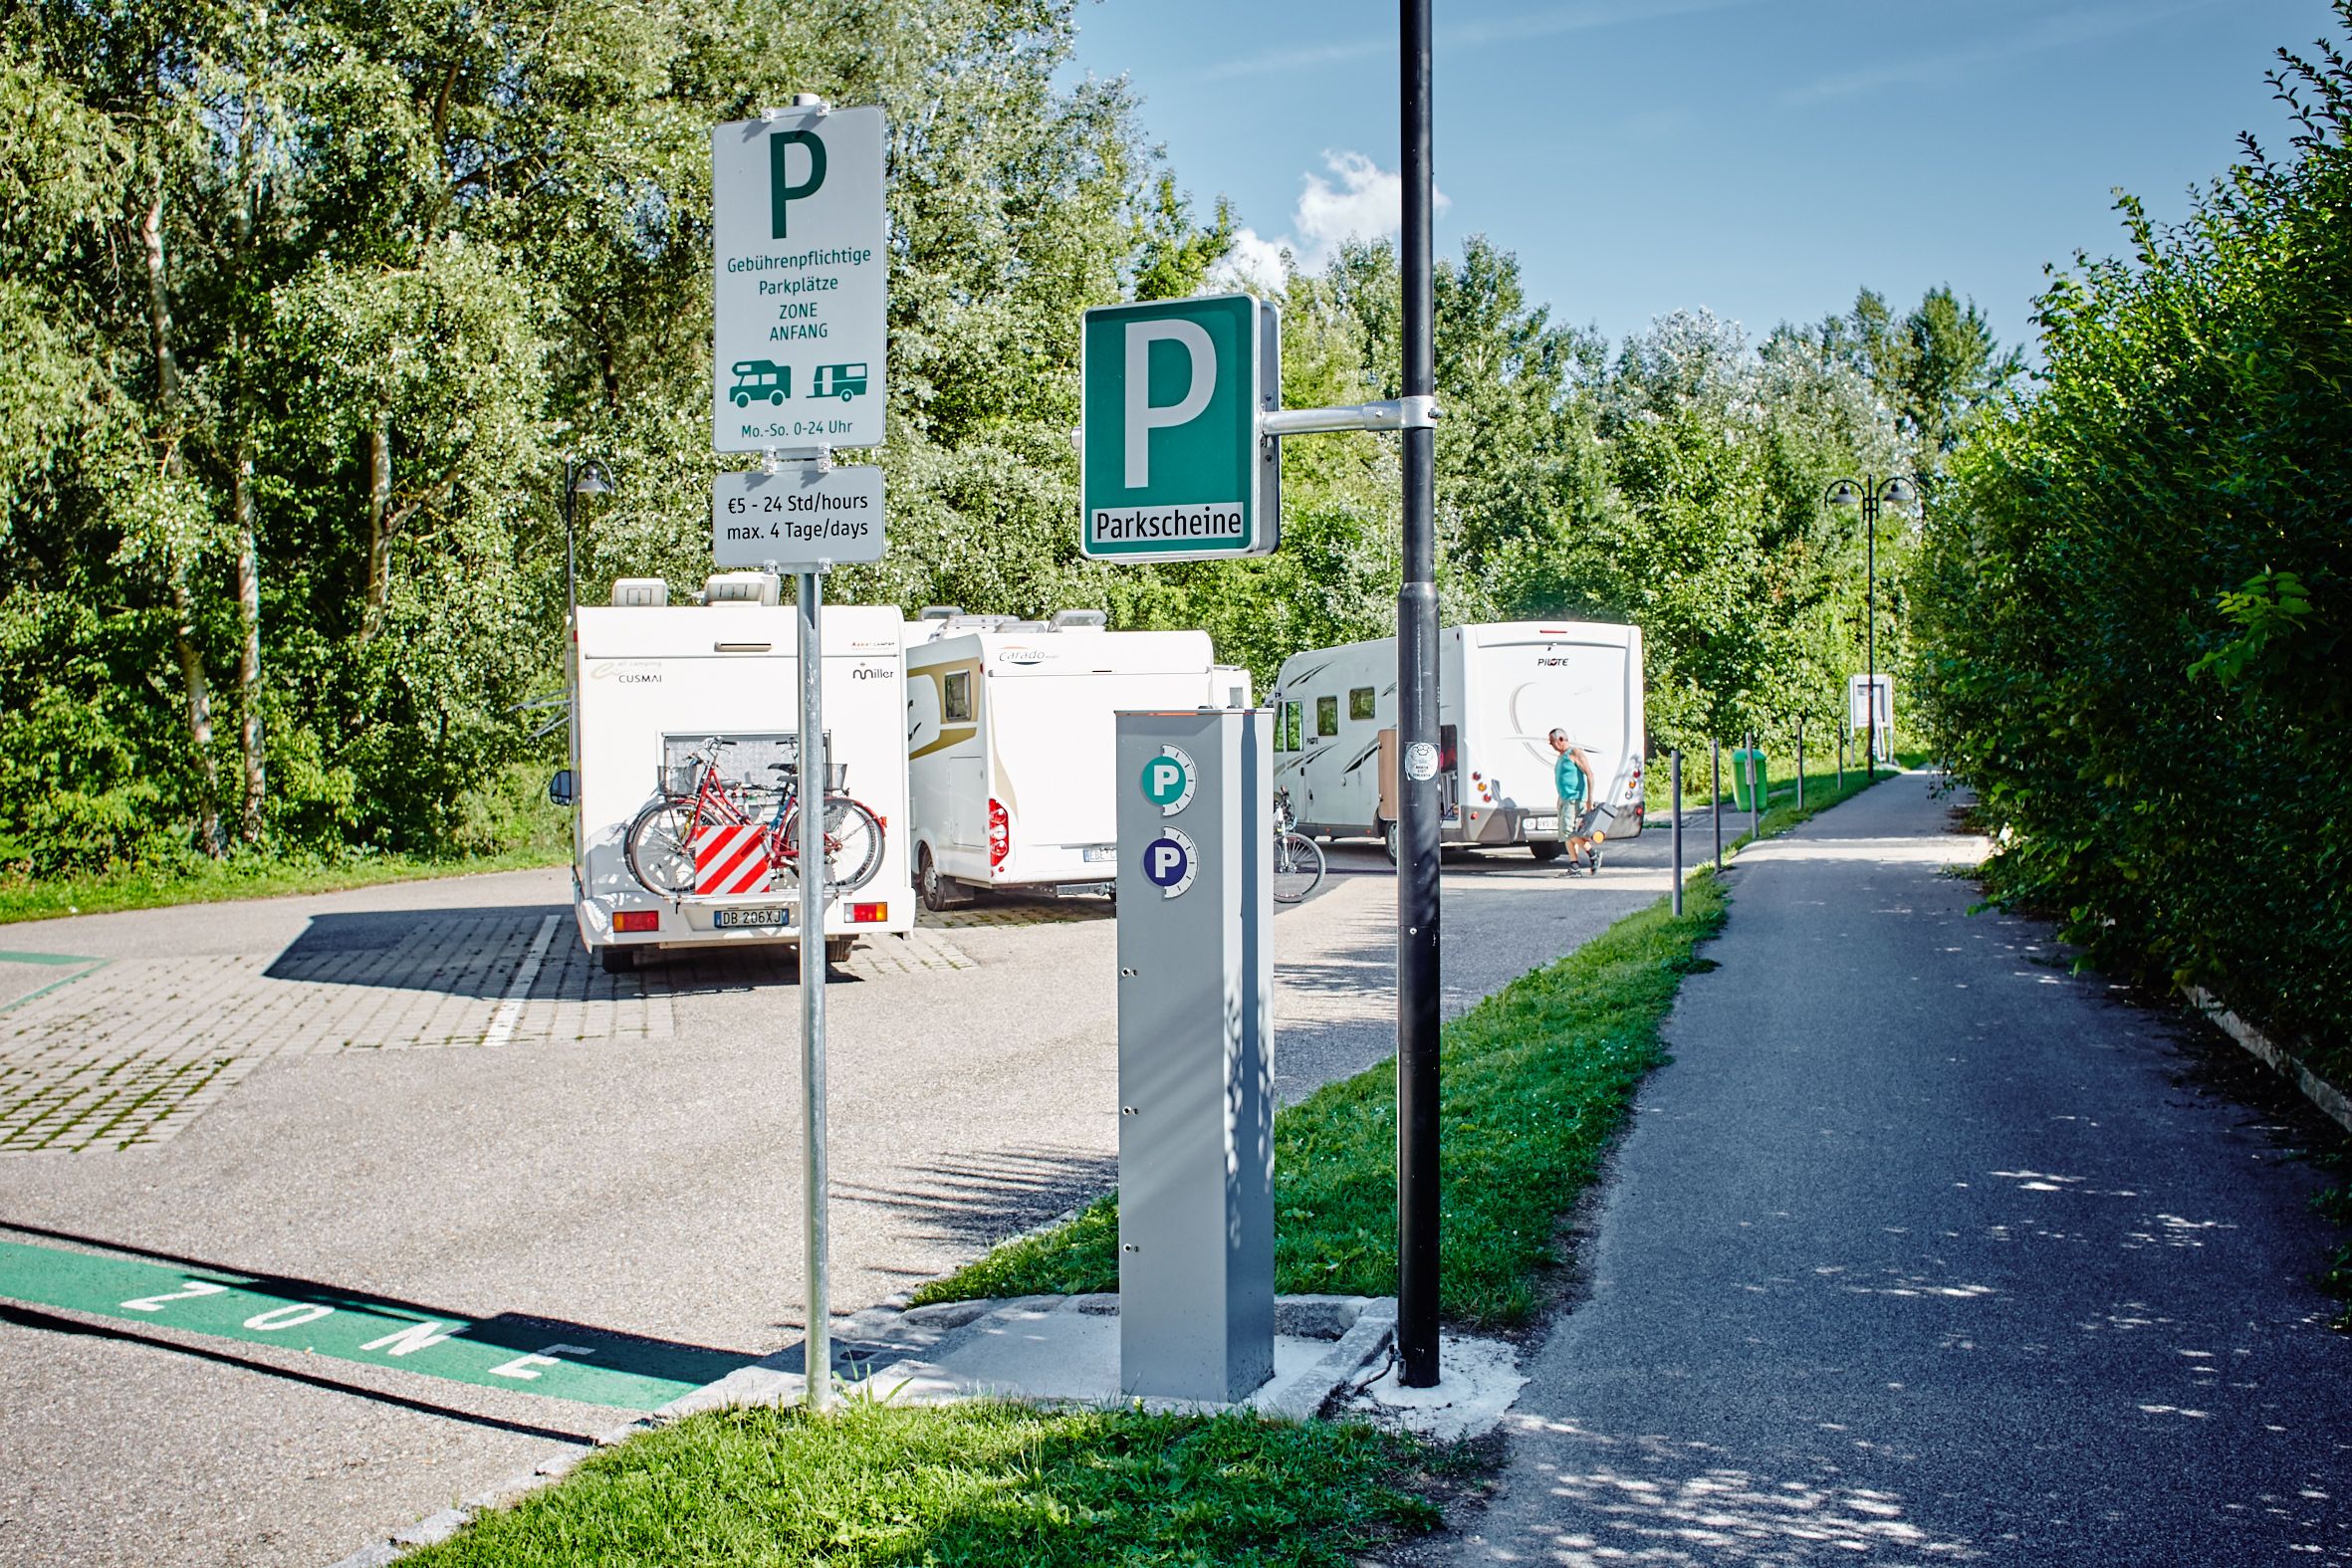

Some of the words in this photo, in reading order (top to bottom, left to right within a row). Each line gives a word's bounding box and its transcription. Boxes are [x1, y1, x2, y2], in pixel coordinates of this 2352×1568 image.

[770, 129, 827, 240] P
[728, 247, 871, 273] Gebührenpflichtige
[759, 276, 838, 296] Parkplätze
[779, 303, 818, 320] ZONE
[770, 324, 827, 341] ANFANG
[1124, 319, 1217, 489] P
[741, 423, 789, 438] Mo.-So.
[794, 420, 823, 436] 0-24
[828, 420, 852, 434] Uhr
[728, 498, 746, 514] €5
[764, 496, 783, 513] 24
[788, 492, 868, 514] Std/hours
[727, 525, 764, 540] max.
[770, 523, 780, 539] 4
[785, 518, 868, 541] Tage/days
[1096, 506, 1241, 539] Parkscheine
[618, 674, 662, 684] CUSMAI
[1154, 765, 1179, 796] P
[1154, 846, 1180, 878] P
[723, 912, 738, 925] DB
[743, 910, 782, 924] 206XJ
[119, 1281, 595, 1380] ZONE
